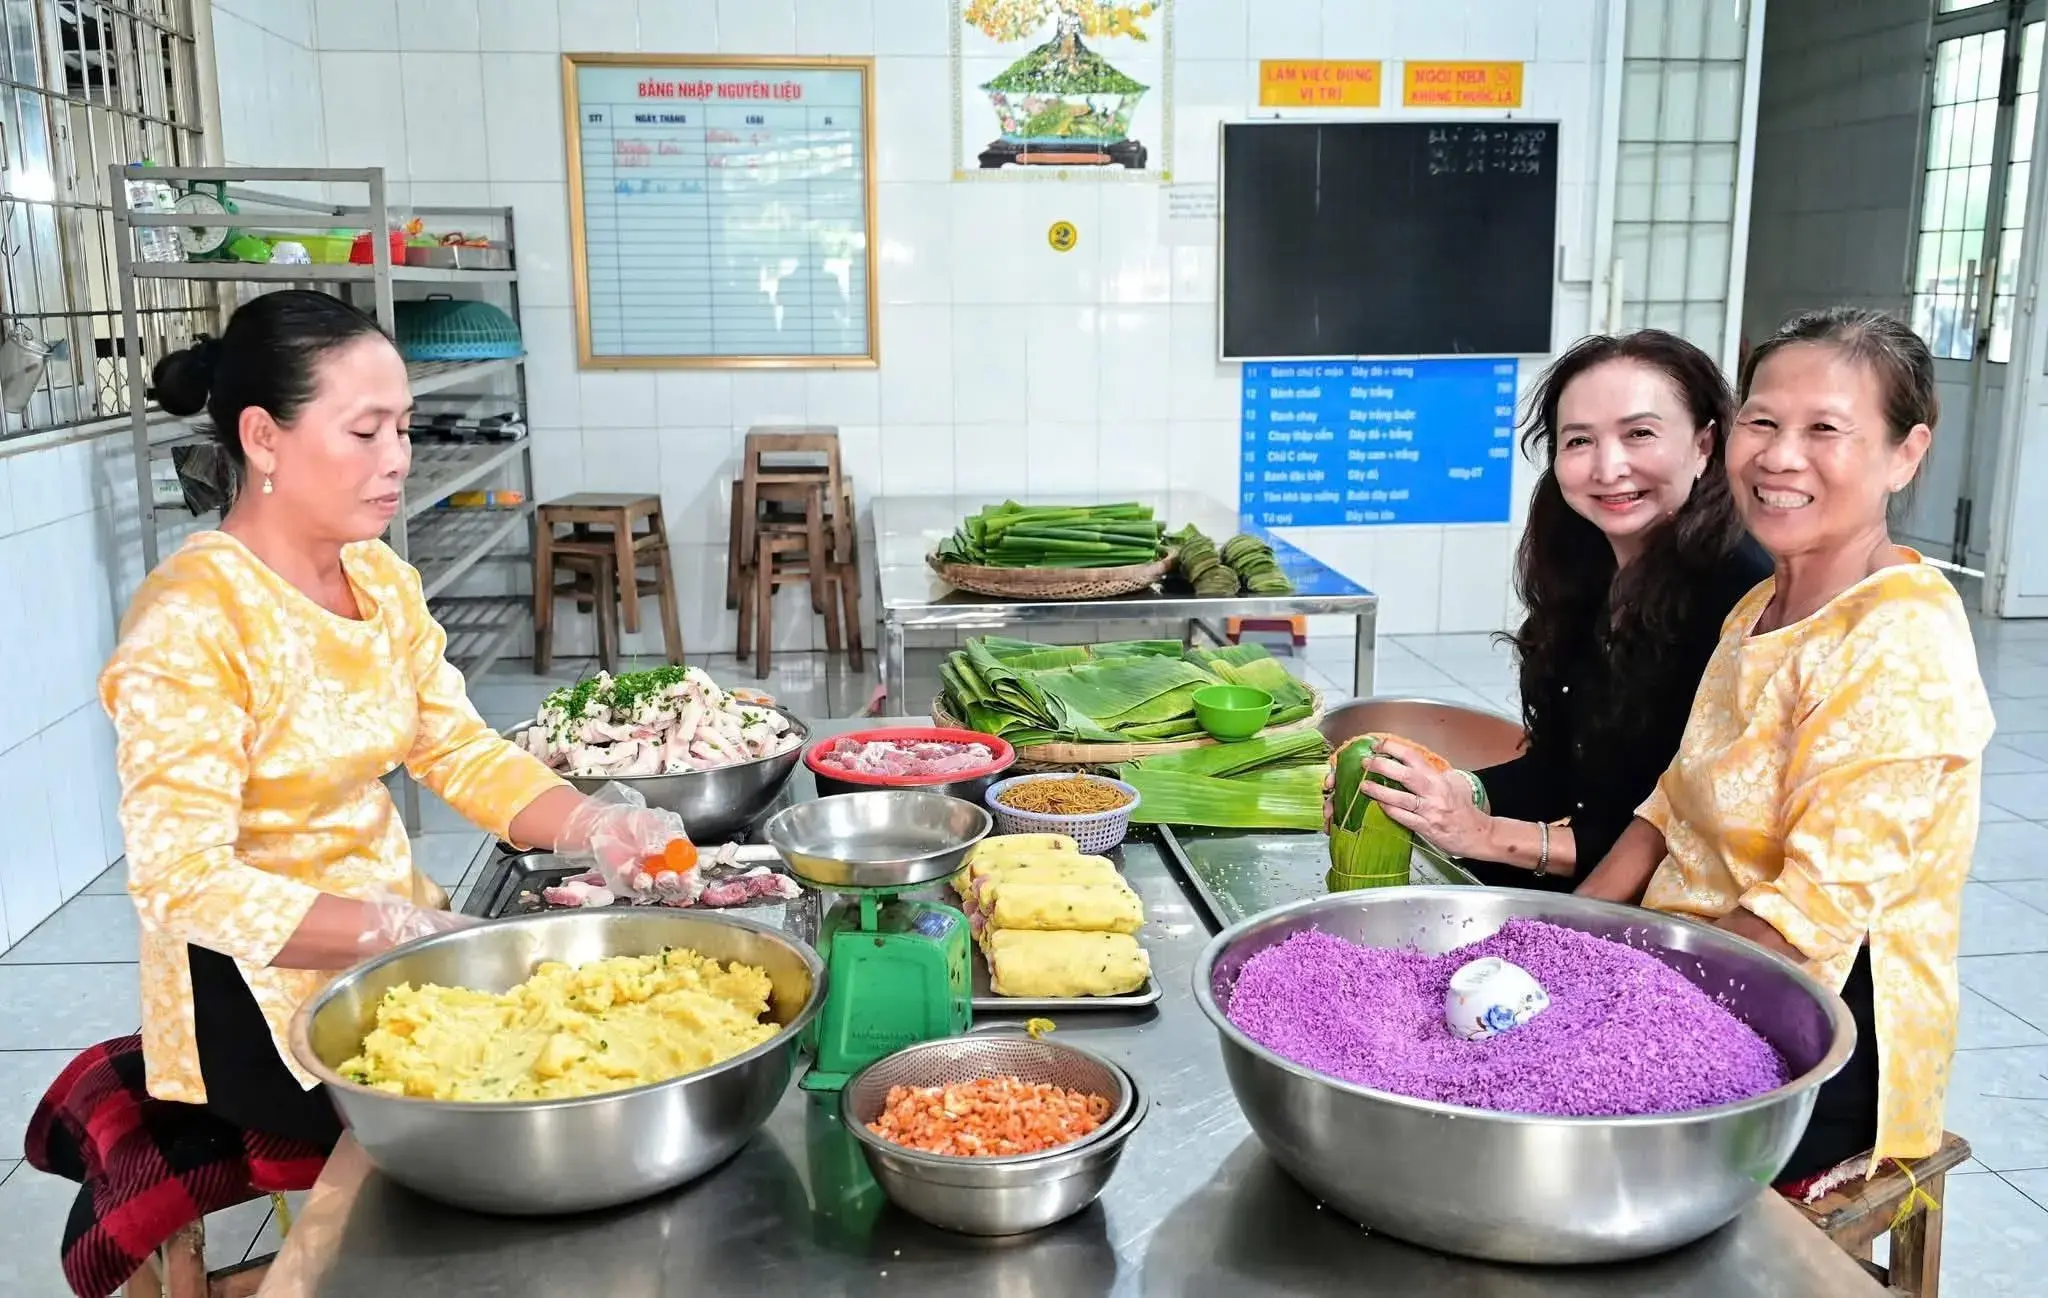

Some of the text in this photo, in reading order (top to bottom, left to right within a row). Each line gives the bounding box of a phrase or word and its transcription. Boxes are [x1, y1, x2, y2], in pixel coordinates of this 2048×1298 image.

[638, 77, 801, 102] BẢNG NHẬP NGUYÊN LIỆU
[588, 114, 603, 123] STT
[1055, 227, 1070, 245] 2
[1248, 367, 1257, 378] 11
